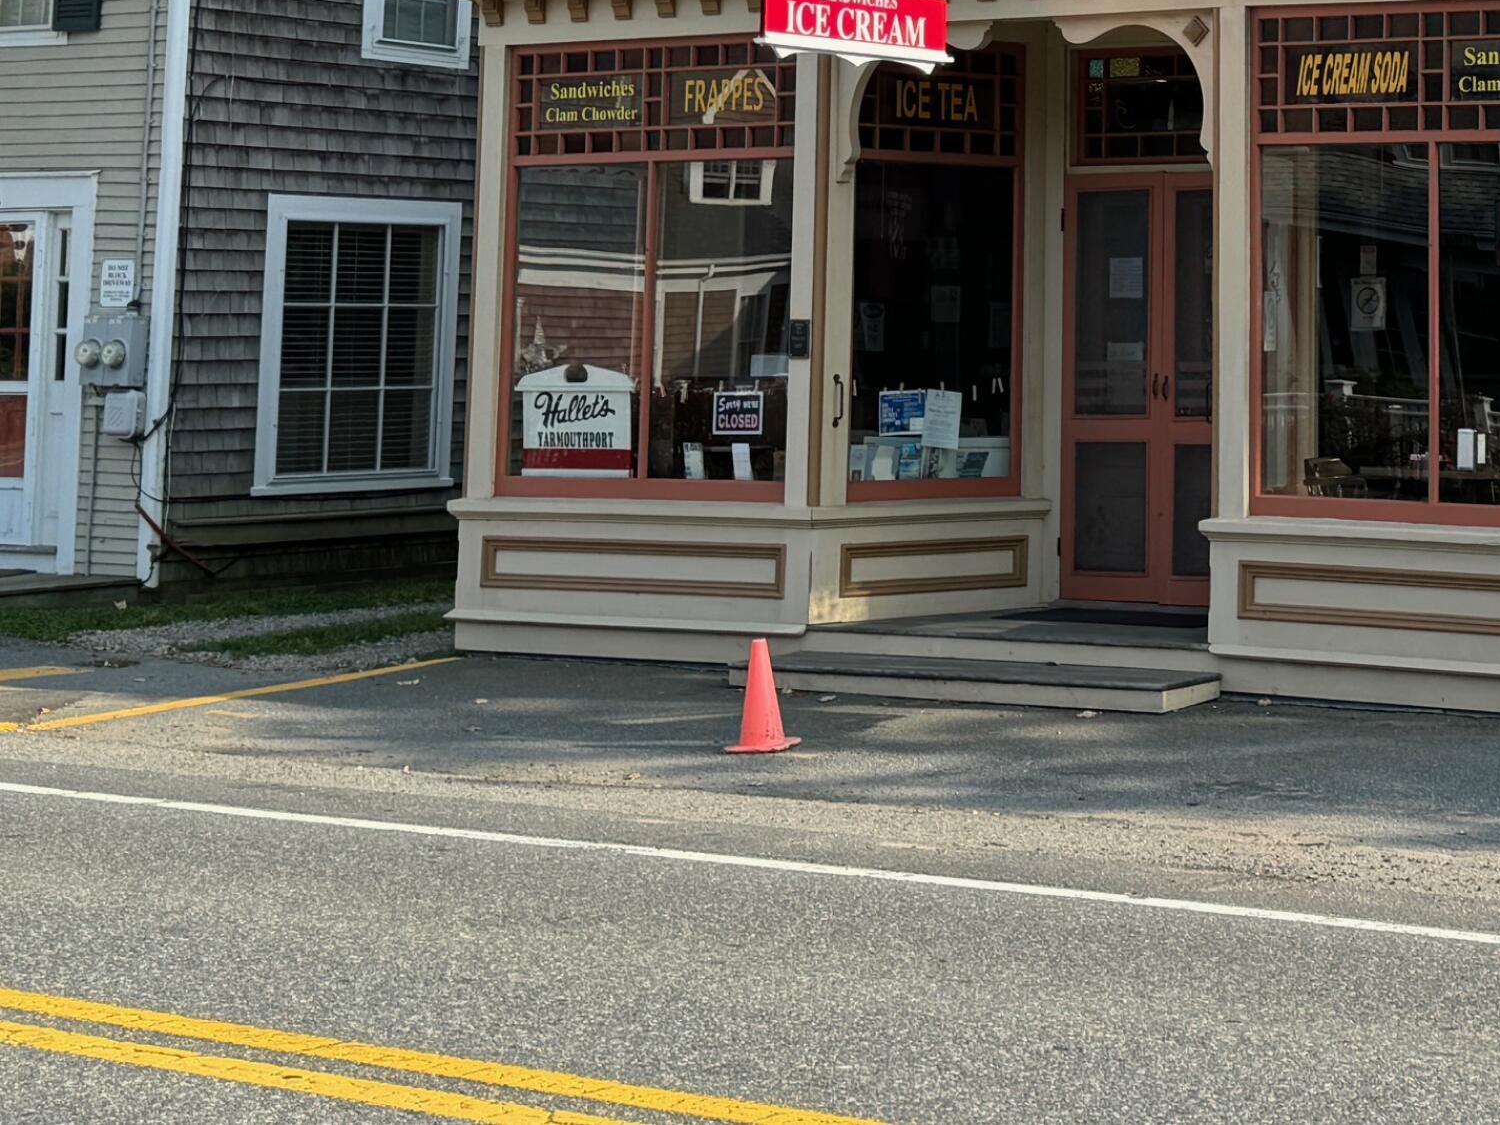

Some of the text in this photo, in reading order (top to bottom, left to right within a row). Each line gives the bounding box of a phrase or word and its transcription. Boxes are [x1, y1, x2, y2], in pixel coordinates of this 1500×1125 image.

[785, 0, 927, 48] ICE CREAM
[1296, 50, 1410, 96] ICE CREAM SODA
[550, 80, 636, 101] Sandwiches
[684, 77, 765, 112] FRAPPES
[895, 79, 979, 123] ICE TEA
[545, 106, 638, 123] Clam Chowder
[534, 391, 616, 429] Hallet's
[719, 397, 741, 411] Sorry
[718, 414, 758, 428] CLOSED
[537, 431, 614, 448] YARMOUTHPORT
